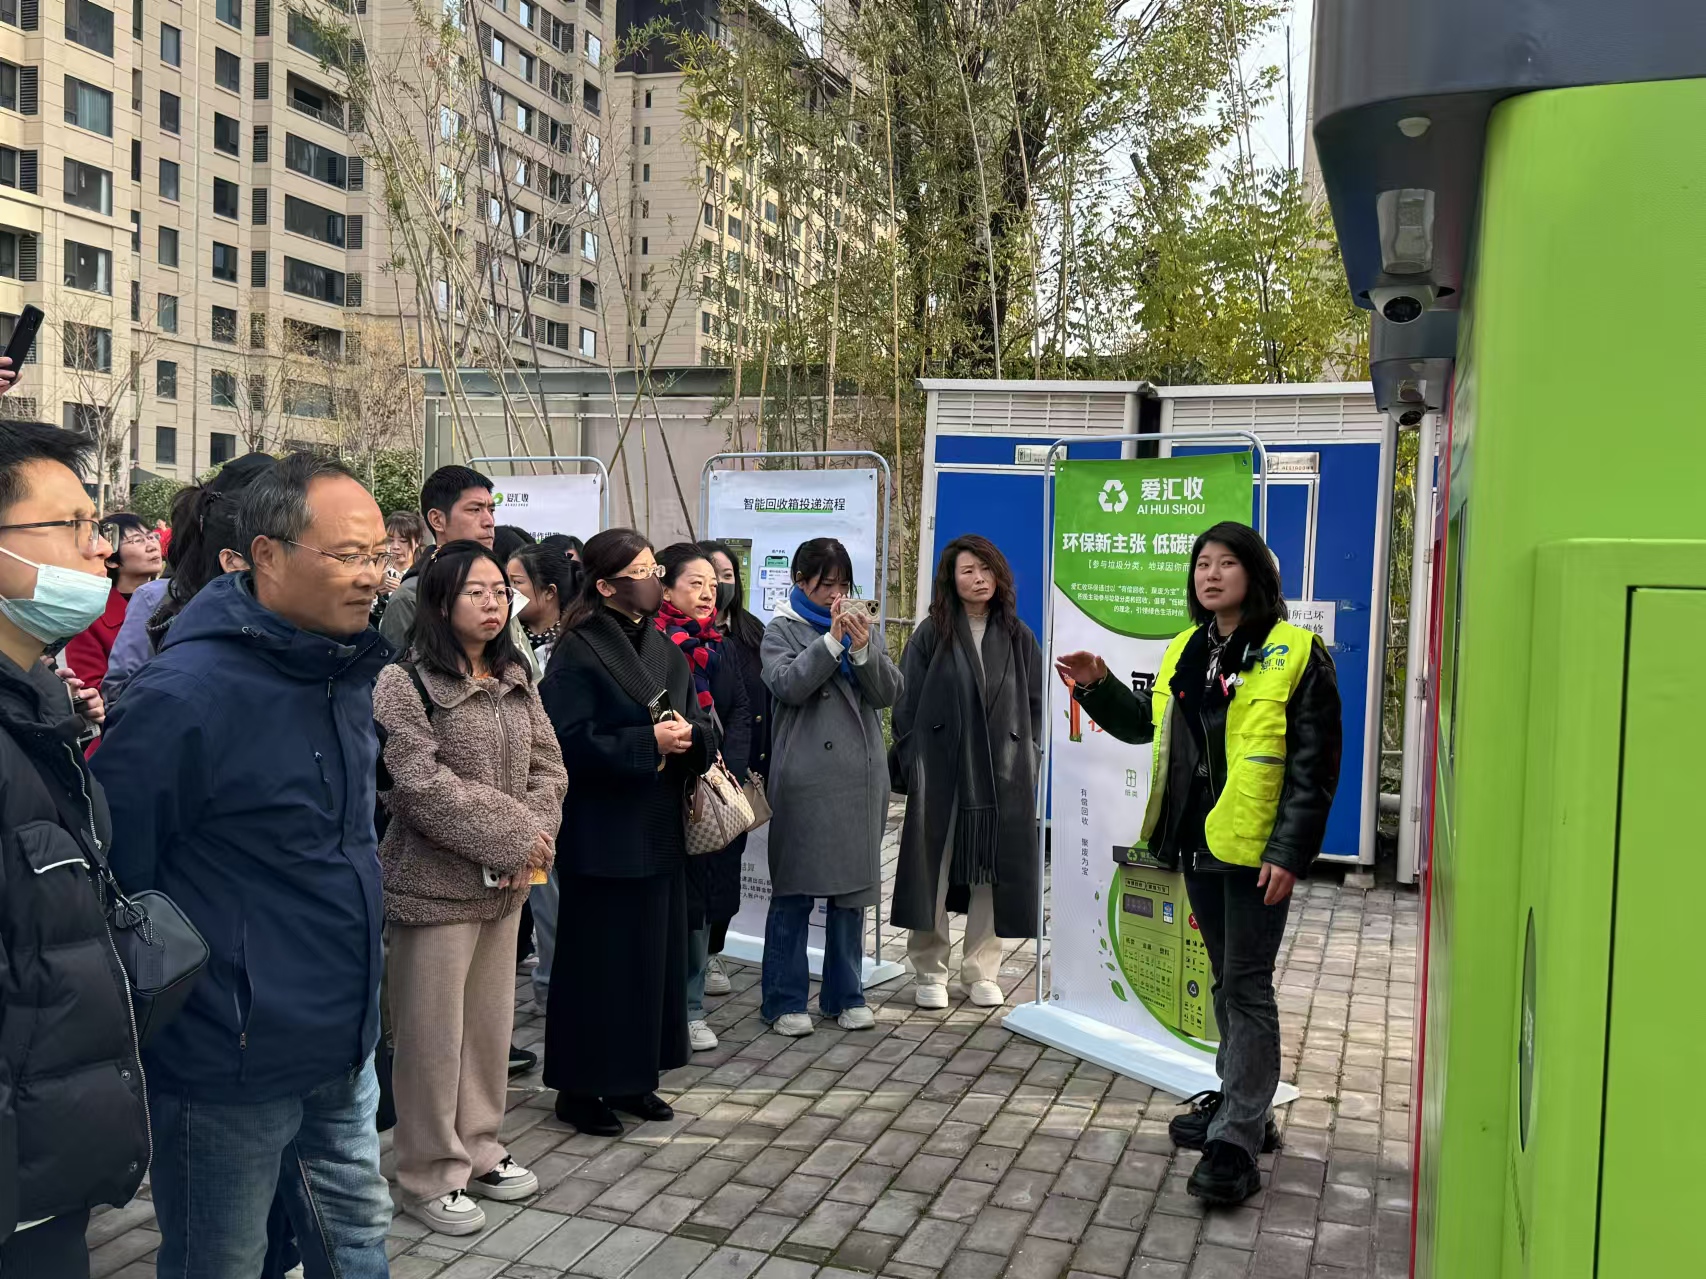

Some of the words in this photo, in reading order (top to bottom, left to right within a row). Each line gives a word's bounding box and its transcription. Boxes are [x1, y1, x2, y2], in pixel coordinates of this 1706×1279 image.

[1141, 476, 1204, 501] 爱汇收
[743, 497, 846, 511] 智能回收箱投递流程
[1137, 505, 1148, 515] AI
[1150, 504, 1169, 515] HUI
[1174, 504, 1206, 515] SHOU
[1062, 533, 1147, 554] 环保新主张
